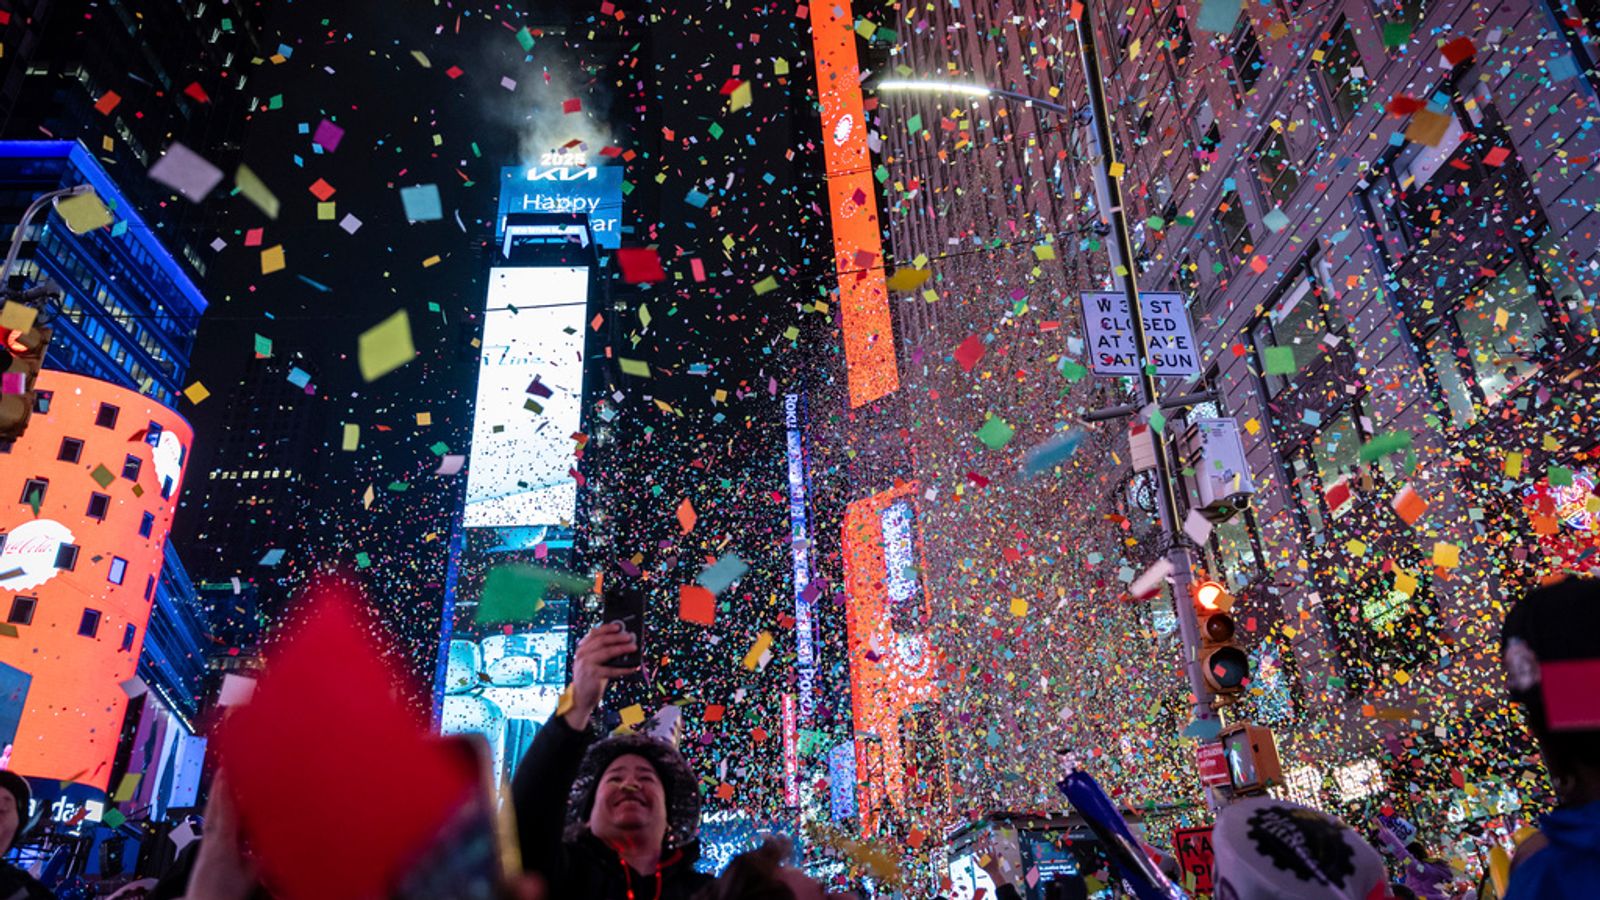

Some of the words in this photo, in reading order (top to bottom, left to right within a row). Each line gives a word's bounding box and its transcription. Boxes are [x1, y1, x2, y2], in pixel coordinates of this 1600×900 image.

[523, 193, 601, 213] Happy
[1096, 300, 1111, 312] W
[1150, 300, 1172, 314] ST
[1098, 335, 1121, 348] AT
[1149, 336, 1188, 350] AVE
[1099, 353, 1136, 366] SAT
[1152, 354, 1192, 367] SUN
